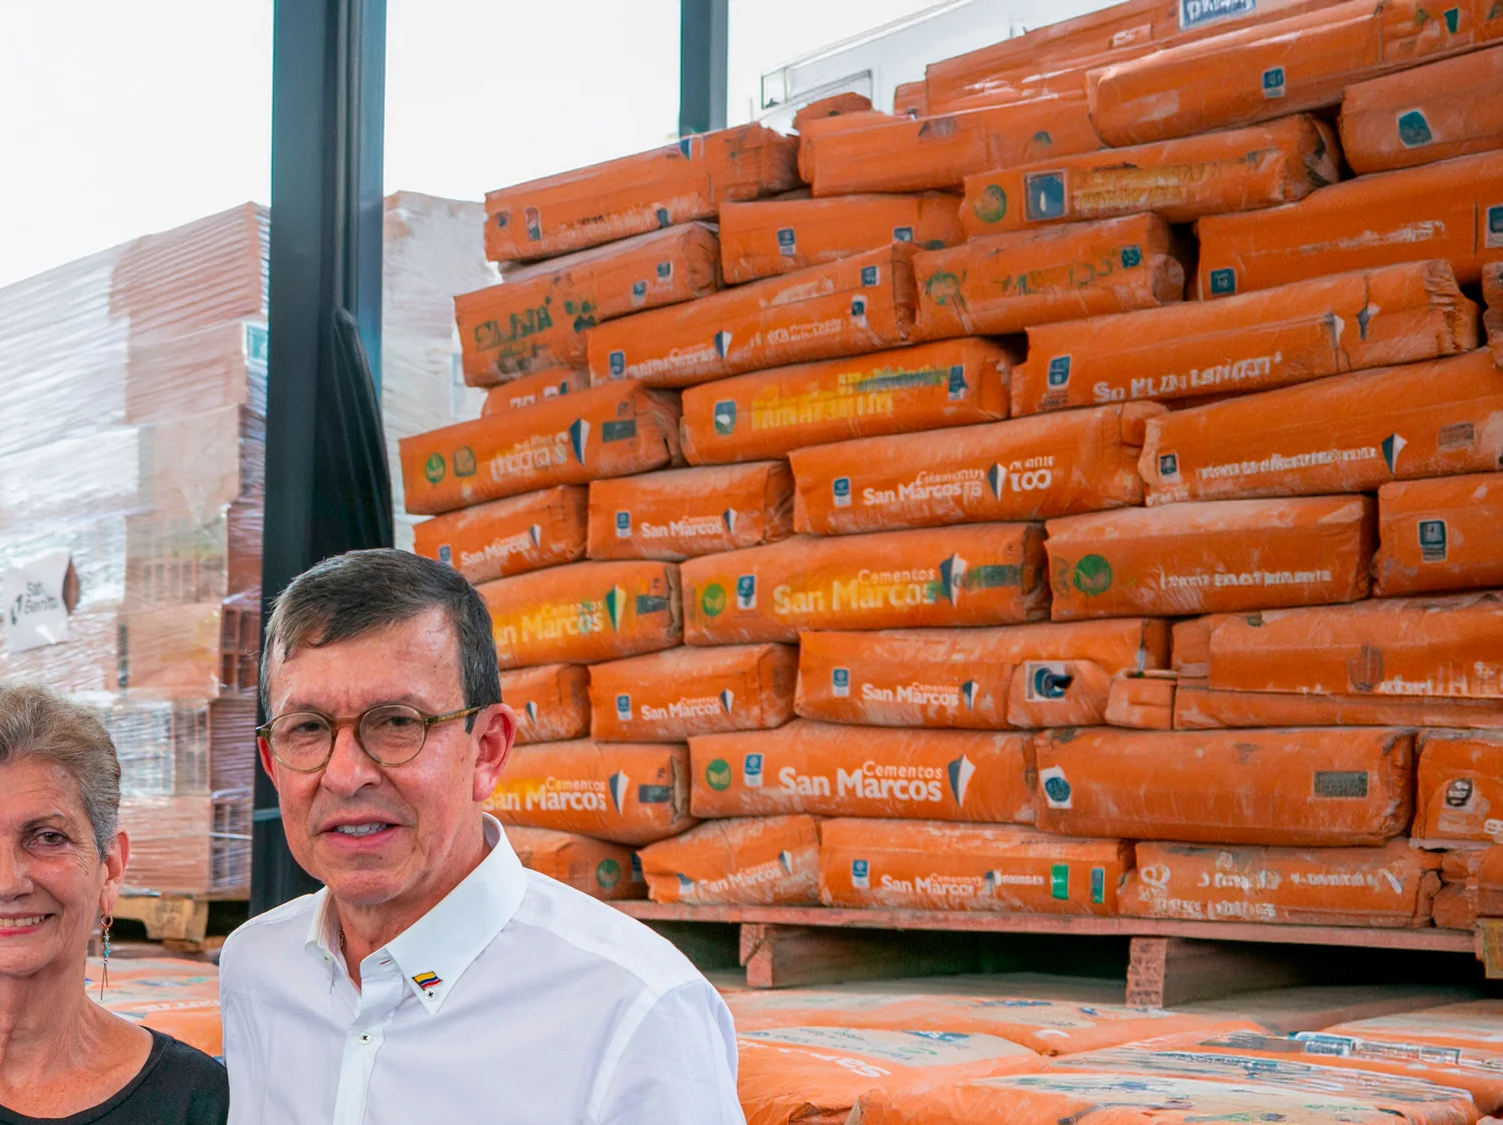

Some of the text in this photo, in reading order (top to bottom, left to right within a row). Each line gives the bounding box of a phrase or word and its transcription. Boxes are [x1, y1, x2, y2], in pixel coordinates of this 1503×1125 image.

[863, 488, 895, 505] San
[641, 520, 722, 538] San Marcos
[858, 569, 935, 585] Cementos
[773, 580, 937, 615] San Marcos
[522, 612, 604, 642] Marcos
[862, 683, 960, 707] San Marcos
[641, 702, 720, 720] San Marcos
[863, 760, 943, 780] Cementos
[546, 776, 605, 791] Cementos
[778, 767, 943, 802] San Marcos
[525, 785, 607, 812] Marcos
[881, 874, 913, 893] San
